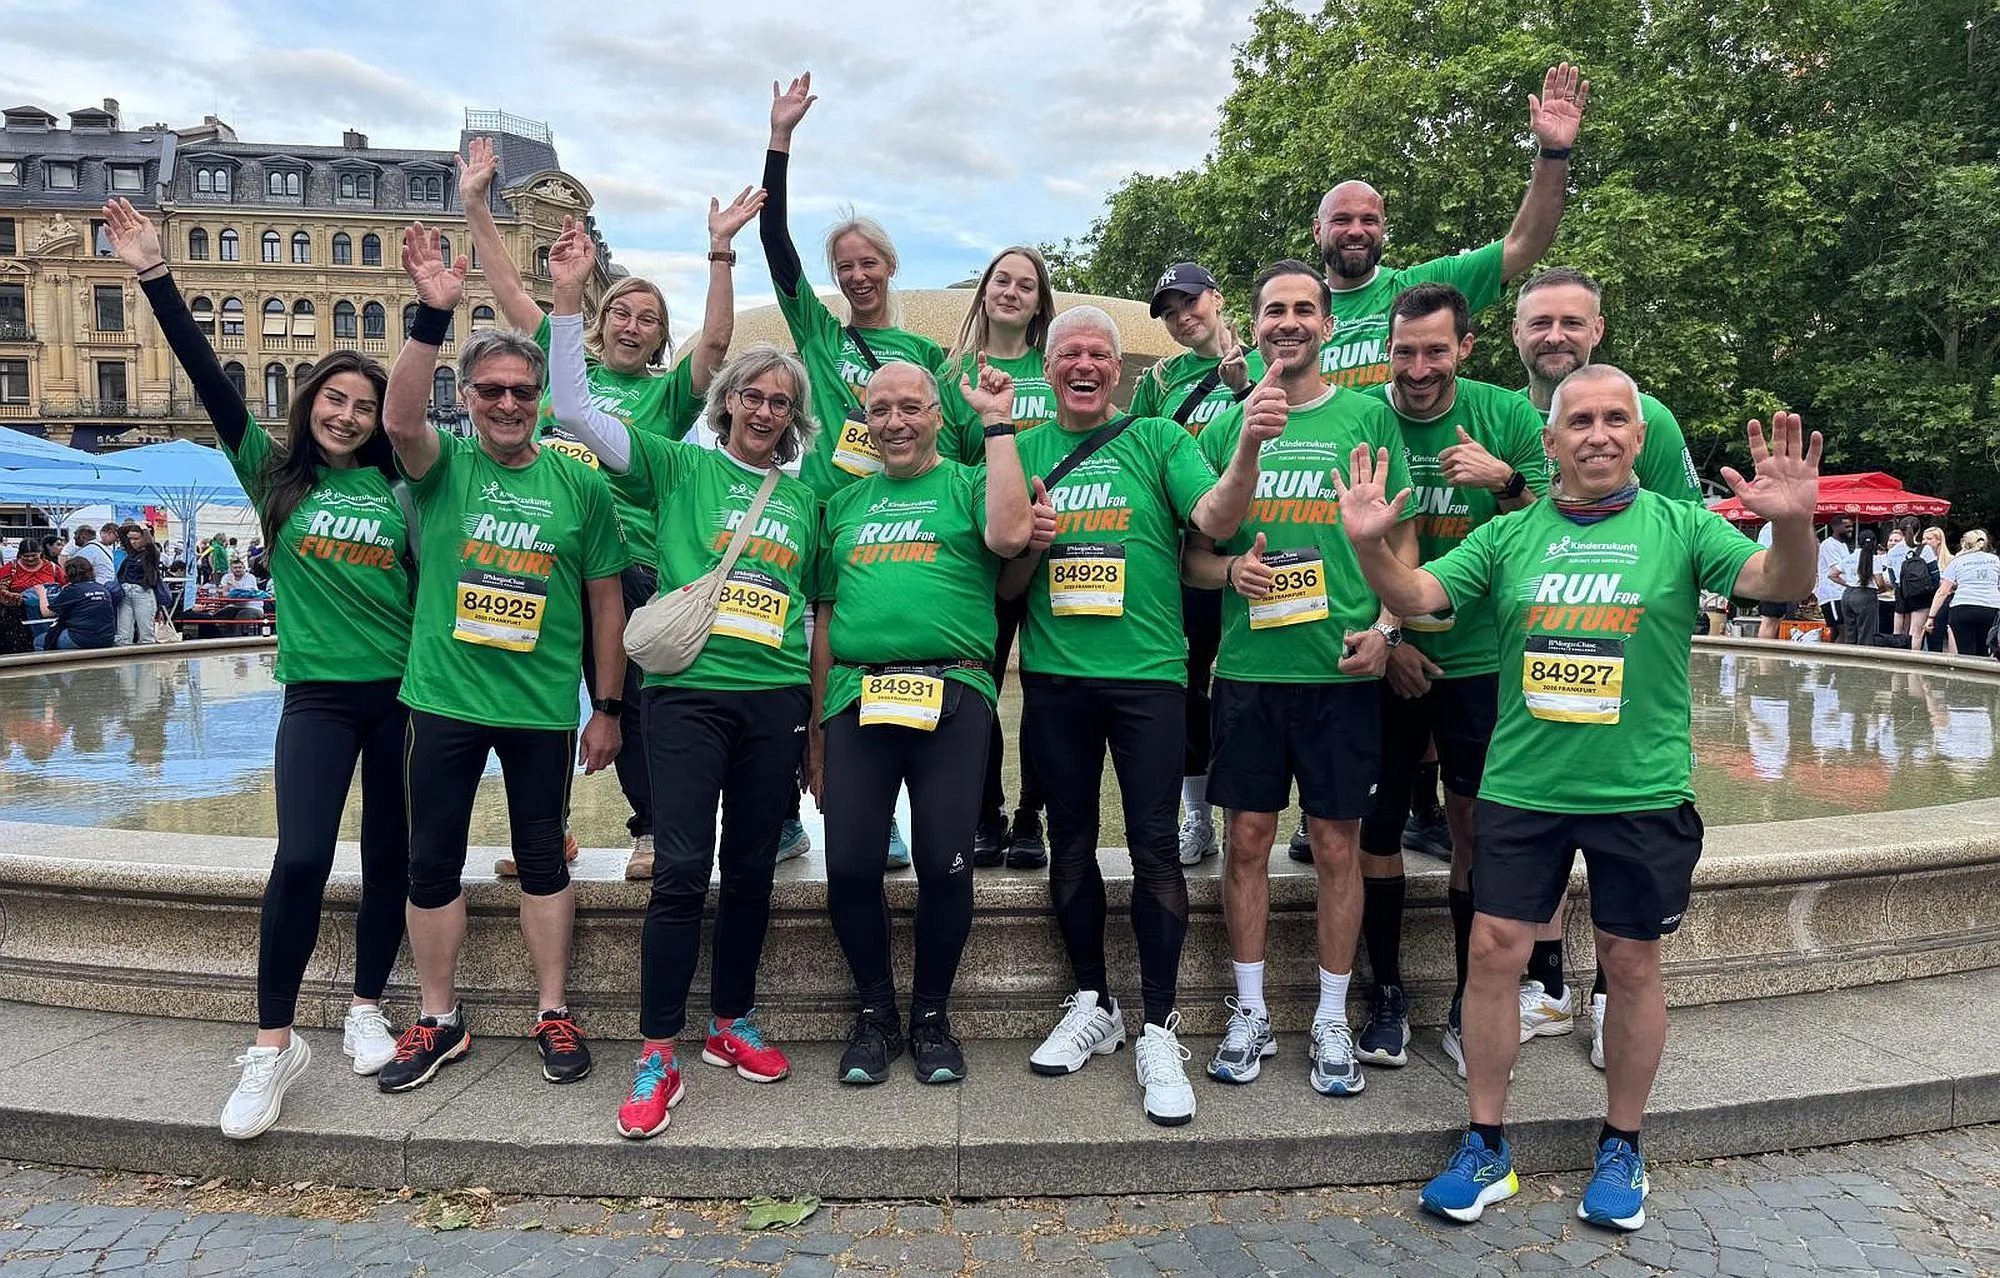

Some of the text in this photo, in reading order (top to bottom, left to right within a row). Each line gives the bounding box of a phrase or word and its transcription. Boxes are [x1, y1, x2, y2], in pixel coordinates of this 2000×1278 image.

[1322, 339, 1391, 373] RUN FO
[841, 361, 873, 386] RU
[612, 407, 633, 417] FOR
[1011, 396, 1046, 419] UN
[1051, 482, 1127, 511] RUN FOR
[1255, 470, 1338, 499] RUN FOR
[1249, 500, 1340, 524] FUTURE
[1415, 486, 1469, 514] UN FOR
[309, 510, 395, 548] RUN FOR
[473, 513, 555, 553] RUN FOR
[857, 519, 936, 545] RUN FOR
[1056, 509, 1133, 534] UTURE
[299, 536, 395, 569] FUTURE
[463, 540, 557, 576] FUTURE
[849, 543, 941, 567] FUTURE
[1570, 542, 1638, 552] Kinderzukunft
[1054, 564, 1118, 583] 84928
[1267, 568, 1317, 593] 936
[719, 586, 781, 616] 84921
[1535, 573, 1641, 604] RUN FOR
[463, 591, 538, 620] 84925
[1527, 605, 1646, 633] FUTURE
[1531, 661, 1614, 686] 84927
[869, 678, 935, 699] 84931
[1558, 685, 1597, 693] FRANKFURT
